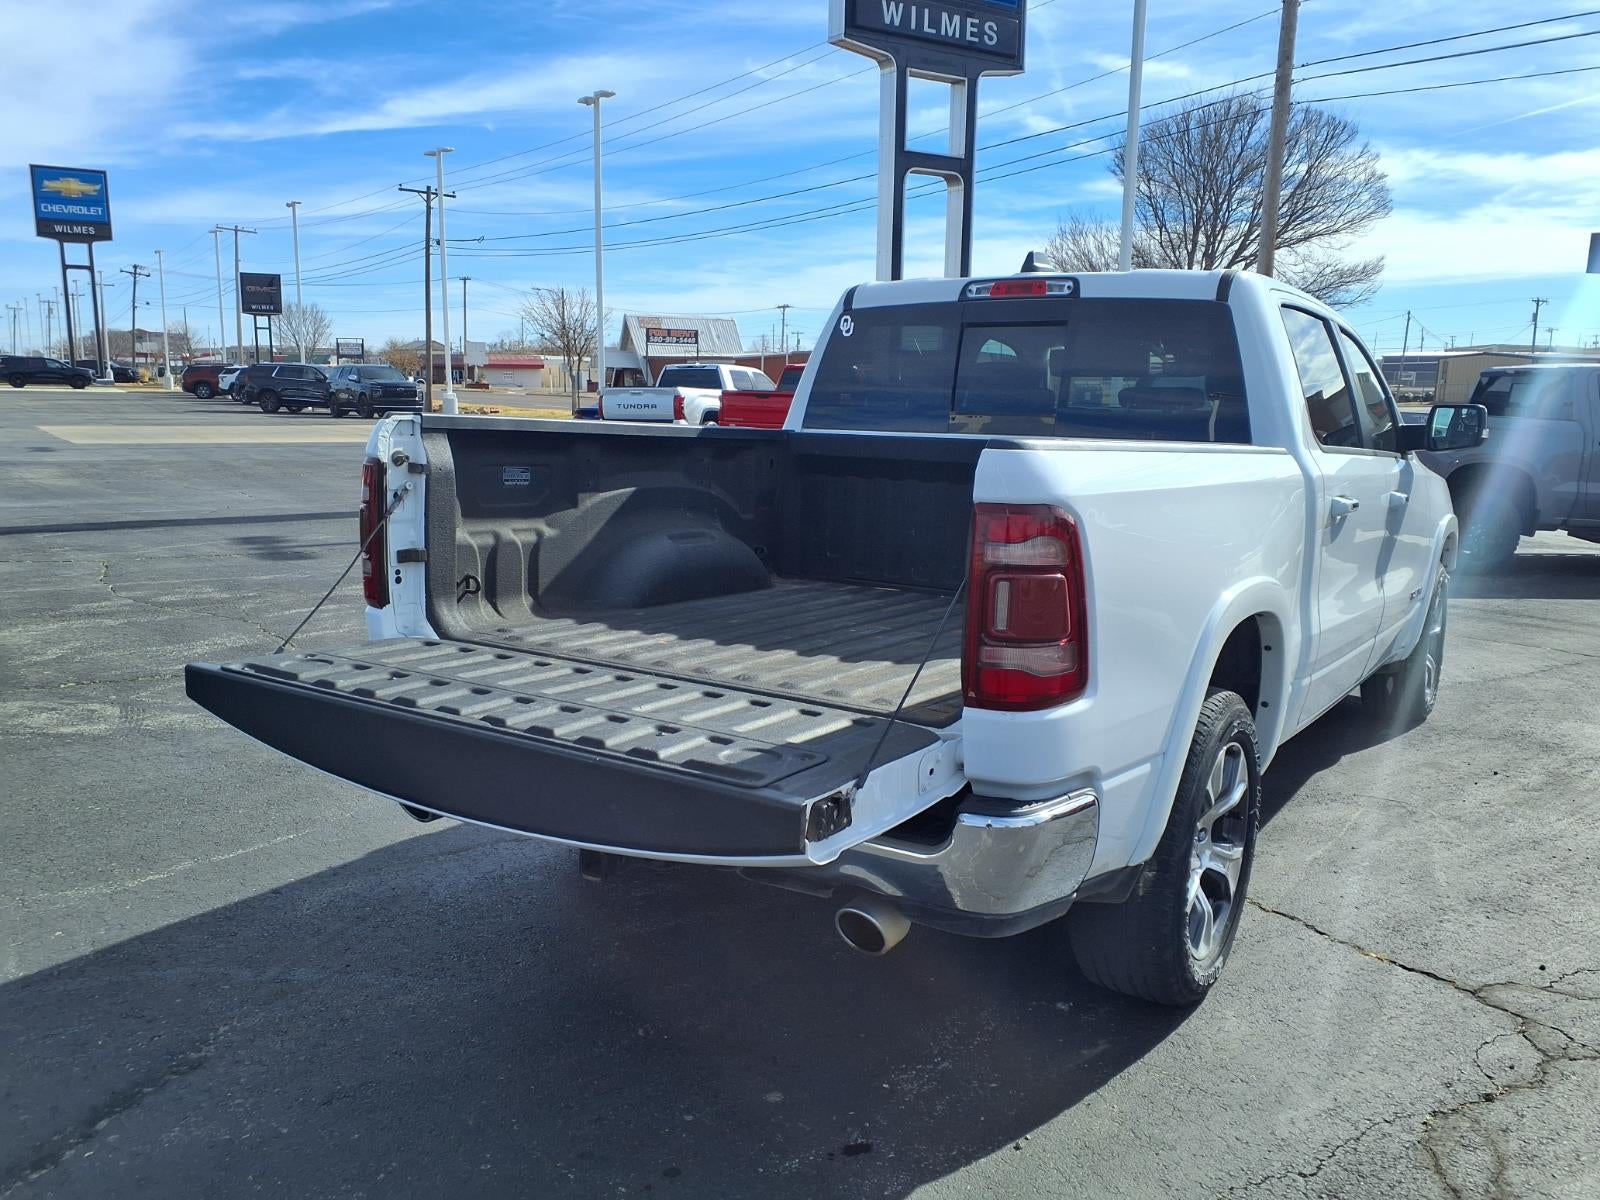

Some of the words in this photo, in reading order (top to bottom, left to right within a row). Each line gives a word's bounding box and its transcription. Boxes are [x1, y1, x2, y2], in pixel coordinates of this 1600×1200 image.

[881, 0, 998, 46] WILMES
[41, 203, 103, 215] CHEVROLET
[54, 224, 96, 235] WILMES
[671, 330, 696, 338] RENT
